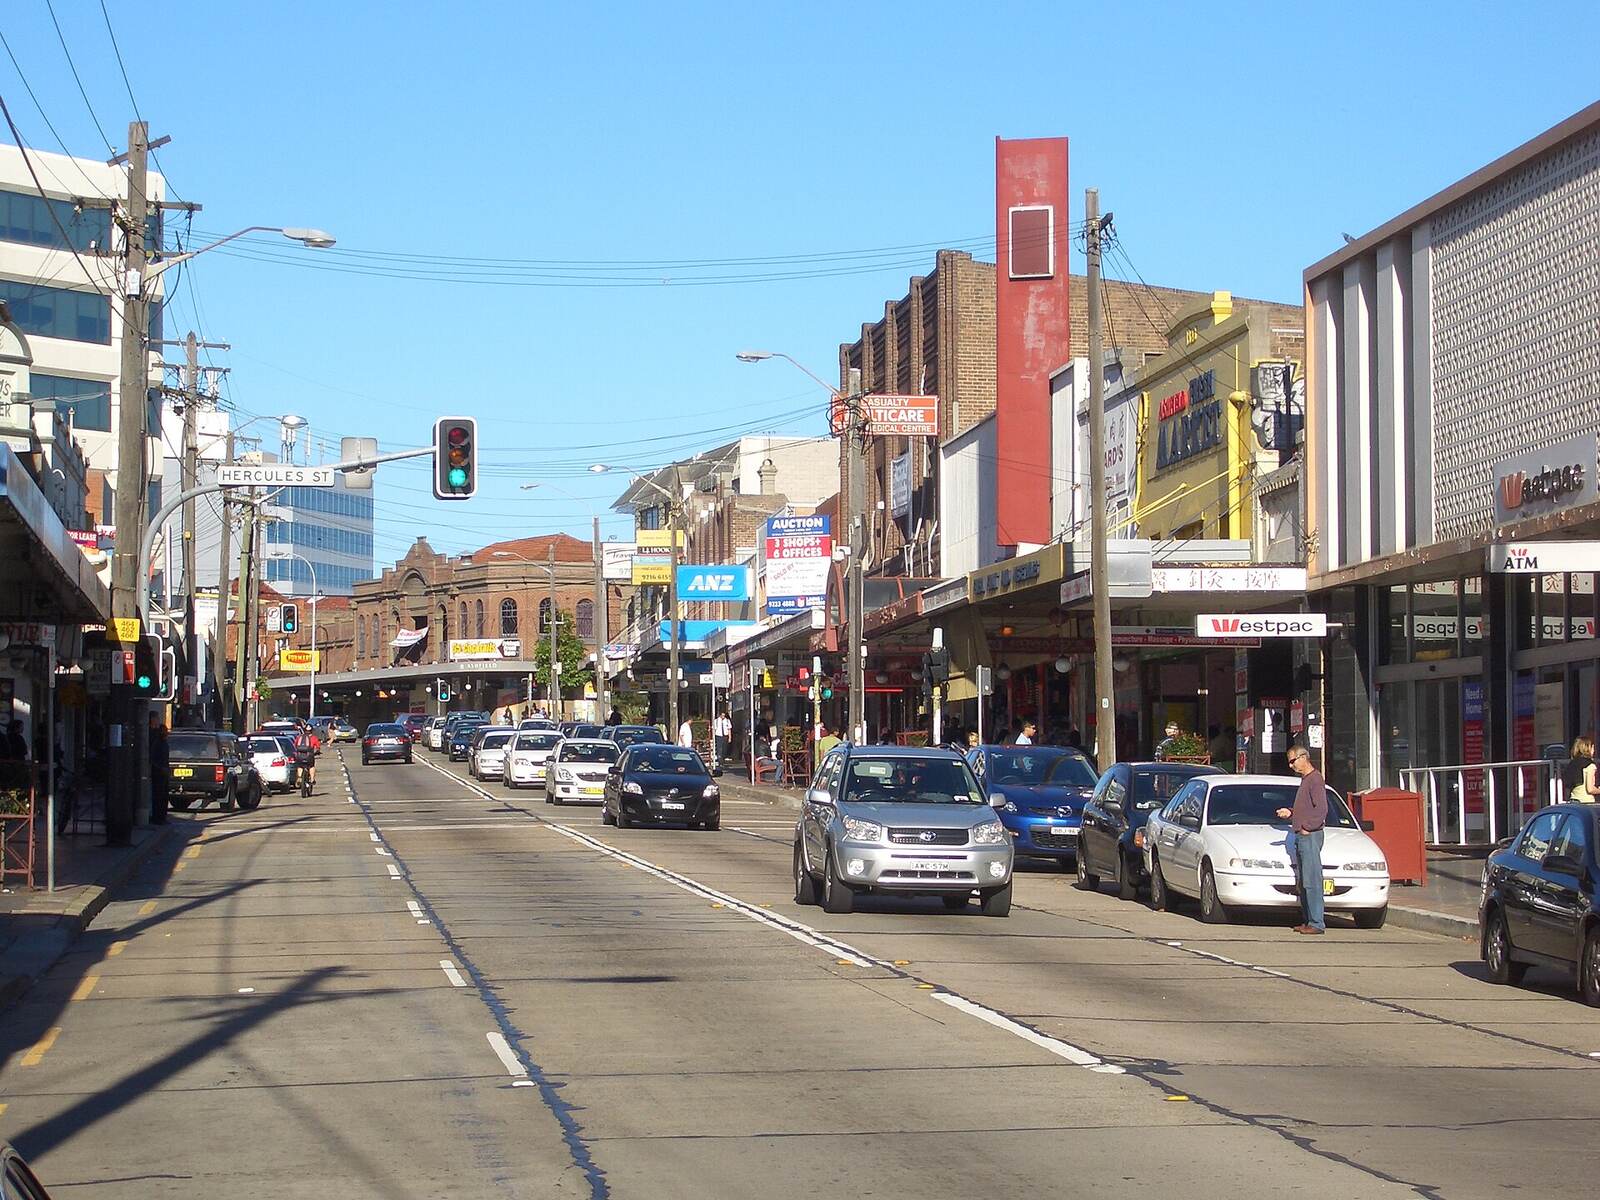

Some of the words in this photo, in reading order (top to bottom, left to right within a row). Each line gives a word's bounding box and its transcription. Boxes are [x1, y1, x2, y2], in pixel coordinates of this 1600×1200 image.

[861, 398, 909, 407] CASUALTY
[901, 424, 932, 432] CENTRE
[222, 470, 304, 482] HERCULES
[313, 471, 330, 483] ST
[1499, 463, 1586, 510] Westpac
[772, 517, 823, 530] AUCTION
[79, 532, 97, 541] LEASE
[774, 539, 780, 548] 3
[782, 537, 822, 548] SHOPS+
[651, 546, 672, 554] HOOK
[773, 549, 780, 558] 6
[782, 547, 822, 558] OFFICES
[1503, 556, 1538, 570] ATM
[687, 574, 735, 591] ANZ
[1211, 618, 1313, 635] Westpac
